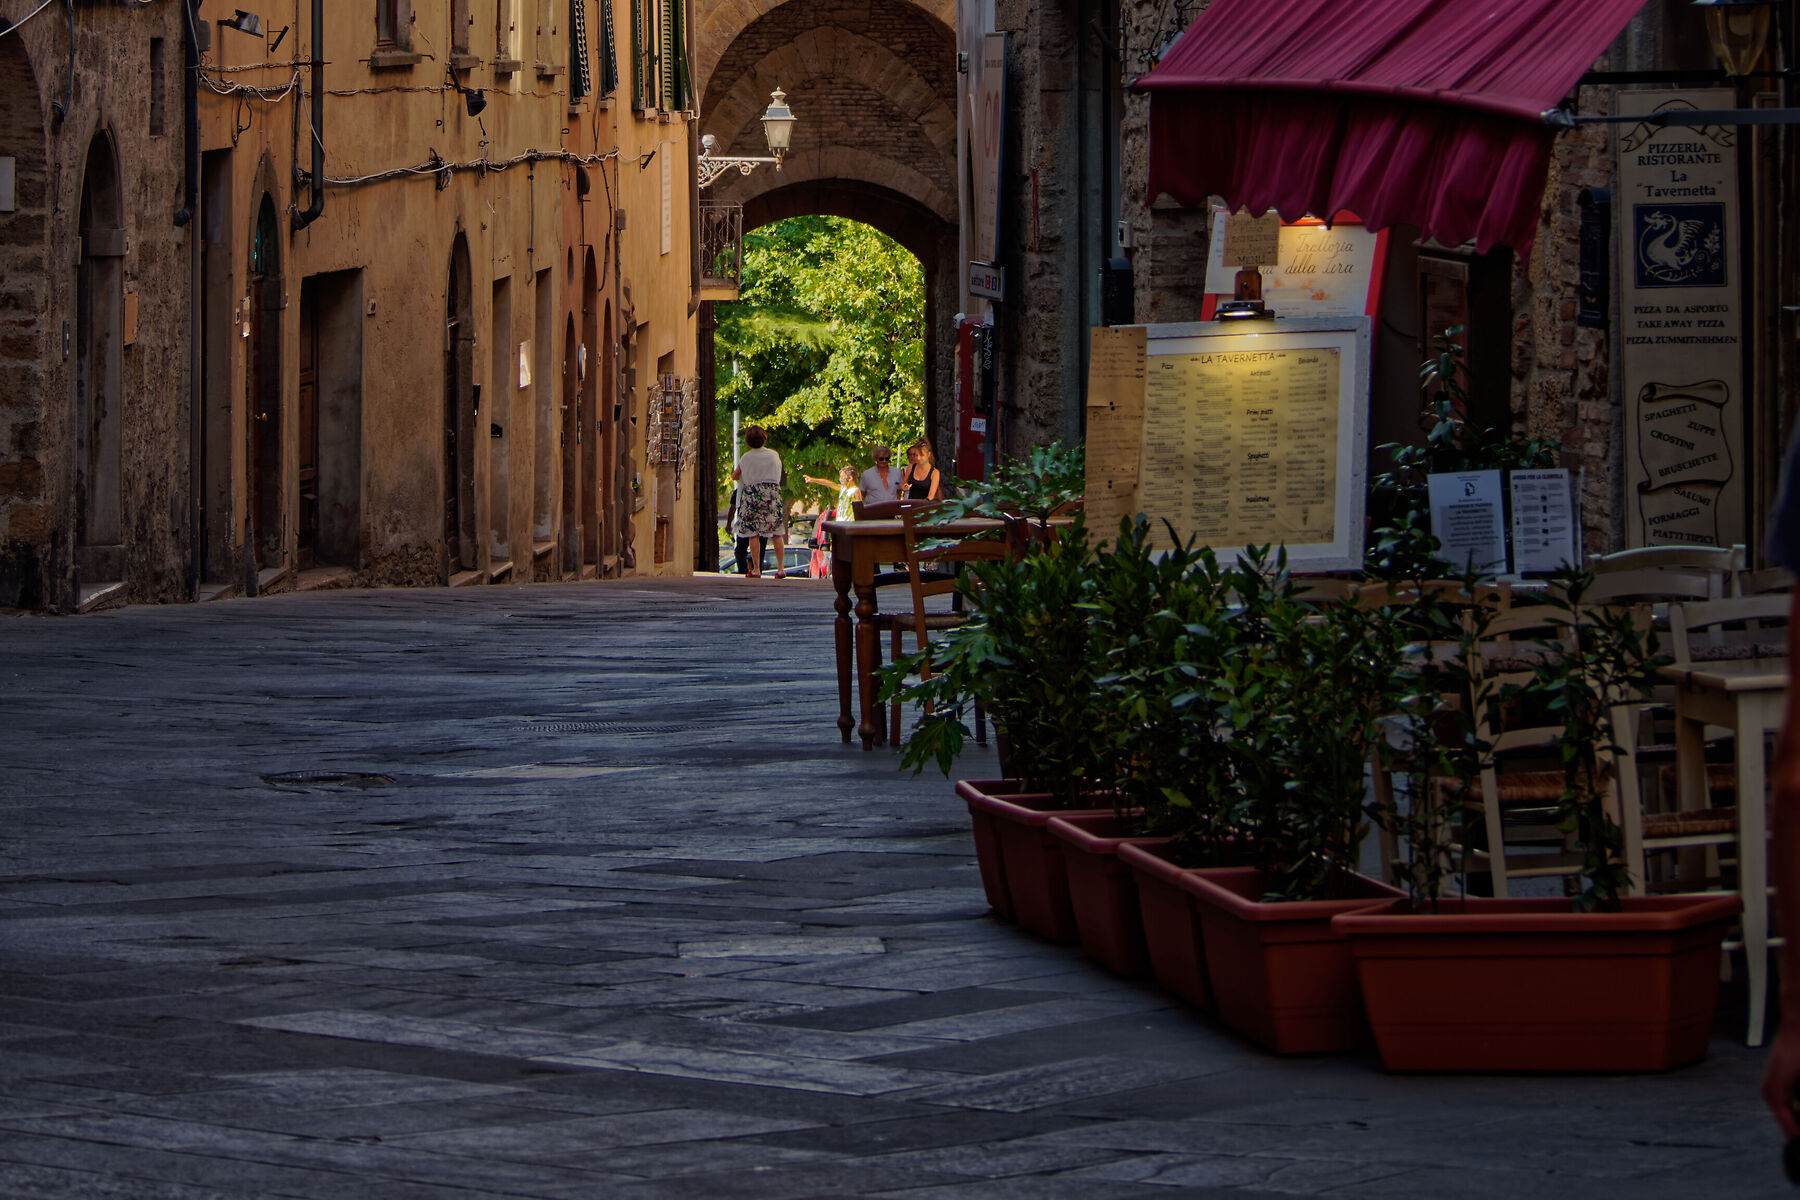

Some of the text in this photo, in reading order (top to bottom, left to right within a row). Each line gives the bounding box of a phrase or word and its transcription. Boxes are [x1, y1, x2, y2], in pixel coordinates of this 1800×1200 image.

[1648, 143, 1707, 154] PIZZERIA
[1637, 153, 1721, 166] RISTORANTE
[1671, 170, 1687, 182] La
[1634, 304, 1729, 314] PIZZA DA ASPORTO
[1637, 320, 1725, 328] TAKE AWAY PIZZA
[1626, 336, 1654, 344] PIZZA
[1201, 353, 1275, 364] LA TAVERNETTA
[1644, 403, 1697, 421] SPAGHETTI
[1687, 421, 1716, 436] ZUPPE
[1650, 430, 1695, 450] CROSTINI
[1658, 453, 1717, 476] BRUSCHETTE
[1673, 487, 1711, 506] SALUMI
[1648, 507, 1700, 525] FORMAGGI
[1653, 529, 1714, 544] PIATTI TIPICI
